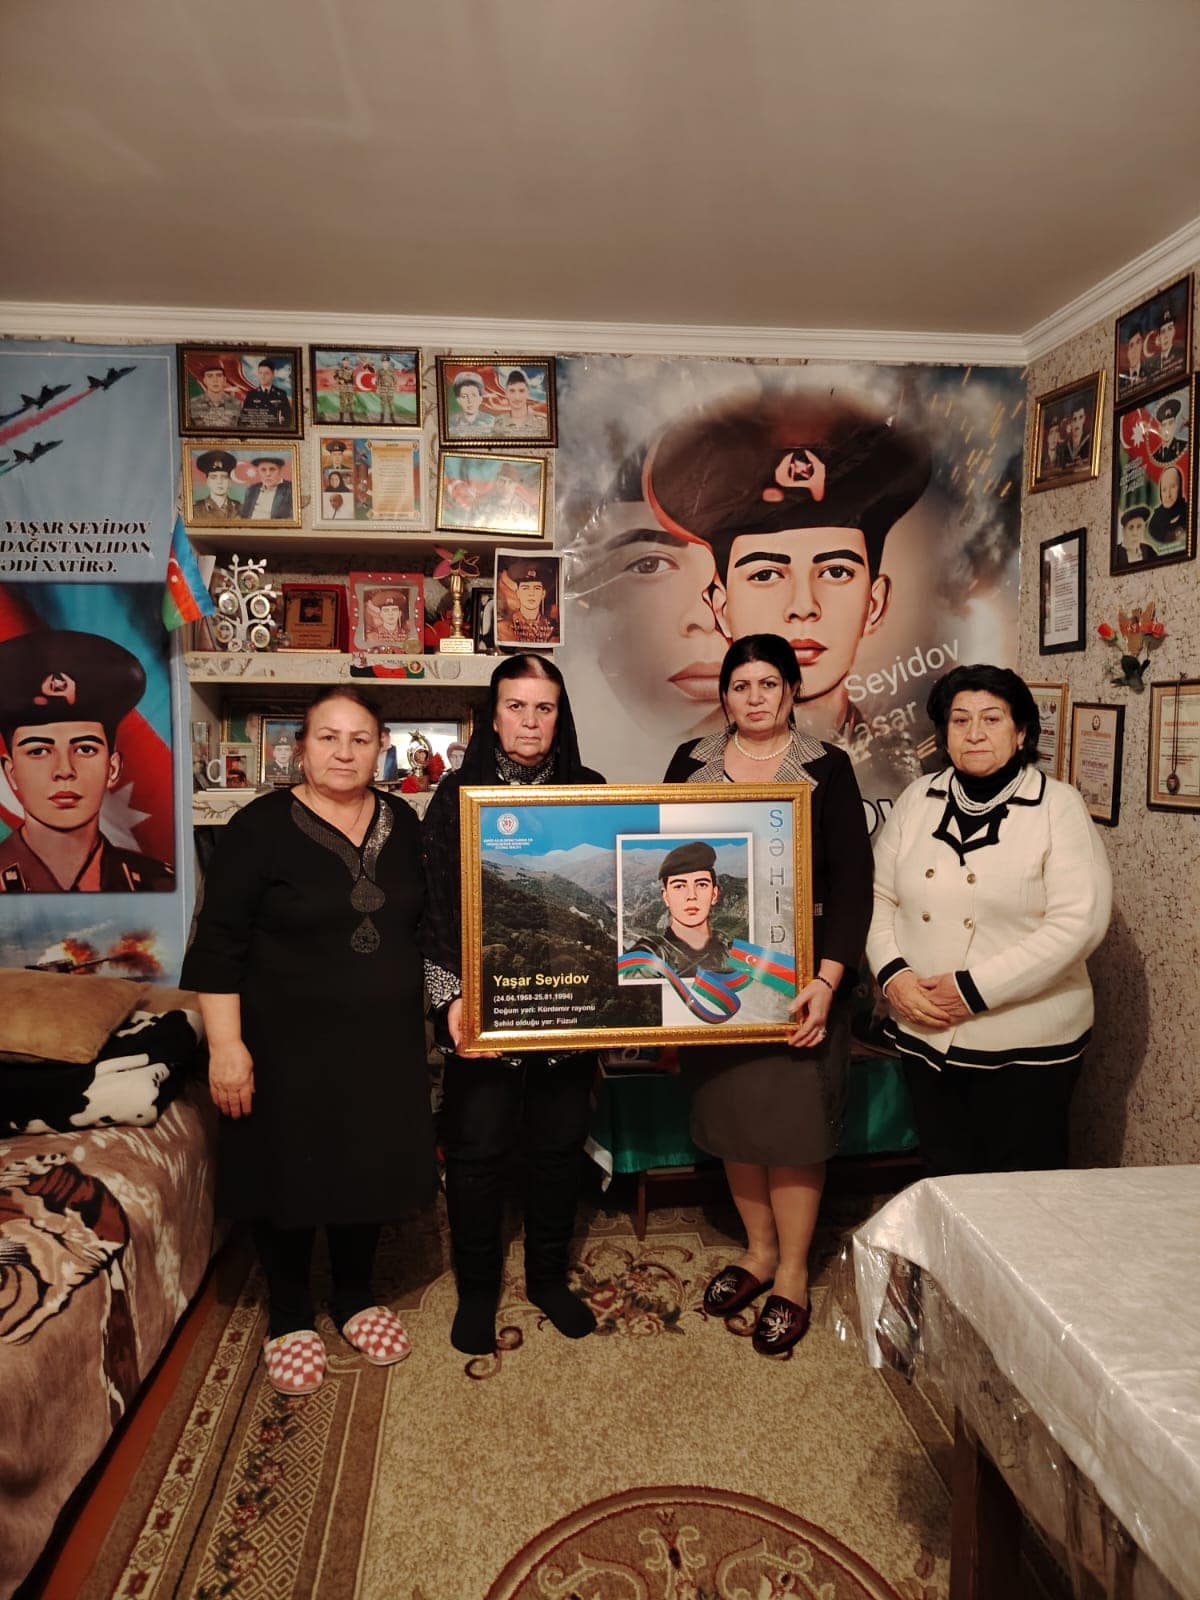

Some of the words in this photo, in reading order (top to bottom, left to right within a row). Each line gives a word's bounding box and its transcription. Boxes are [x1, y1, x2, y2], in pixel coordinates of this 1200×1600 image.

[5, 520, 64, 536] YAŞAR
[68, 518, 150, 534] SEYİDOV
[844, 639, 960, 702] Seyidov
[493, 975, 531, 988] Yaşar
[535, 973, 589, 987] Seyidov
